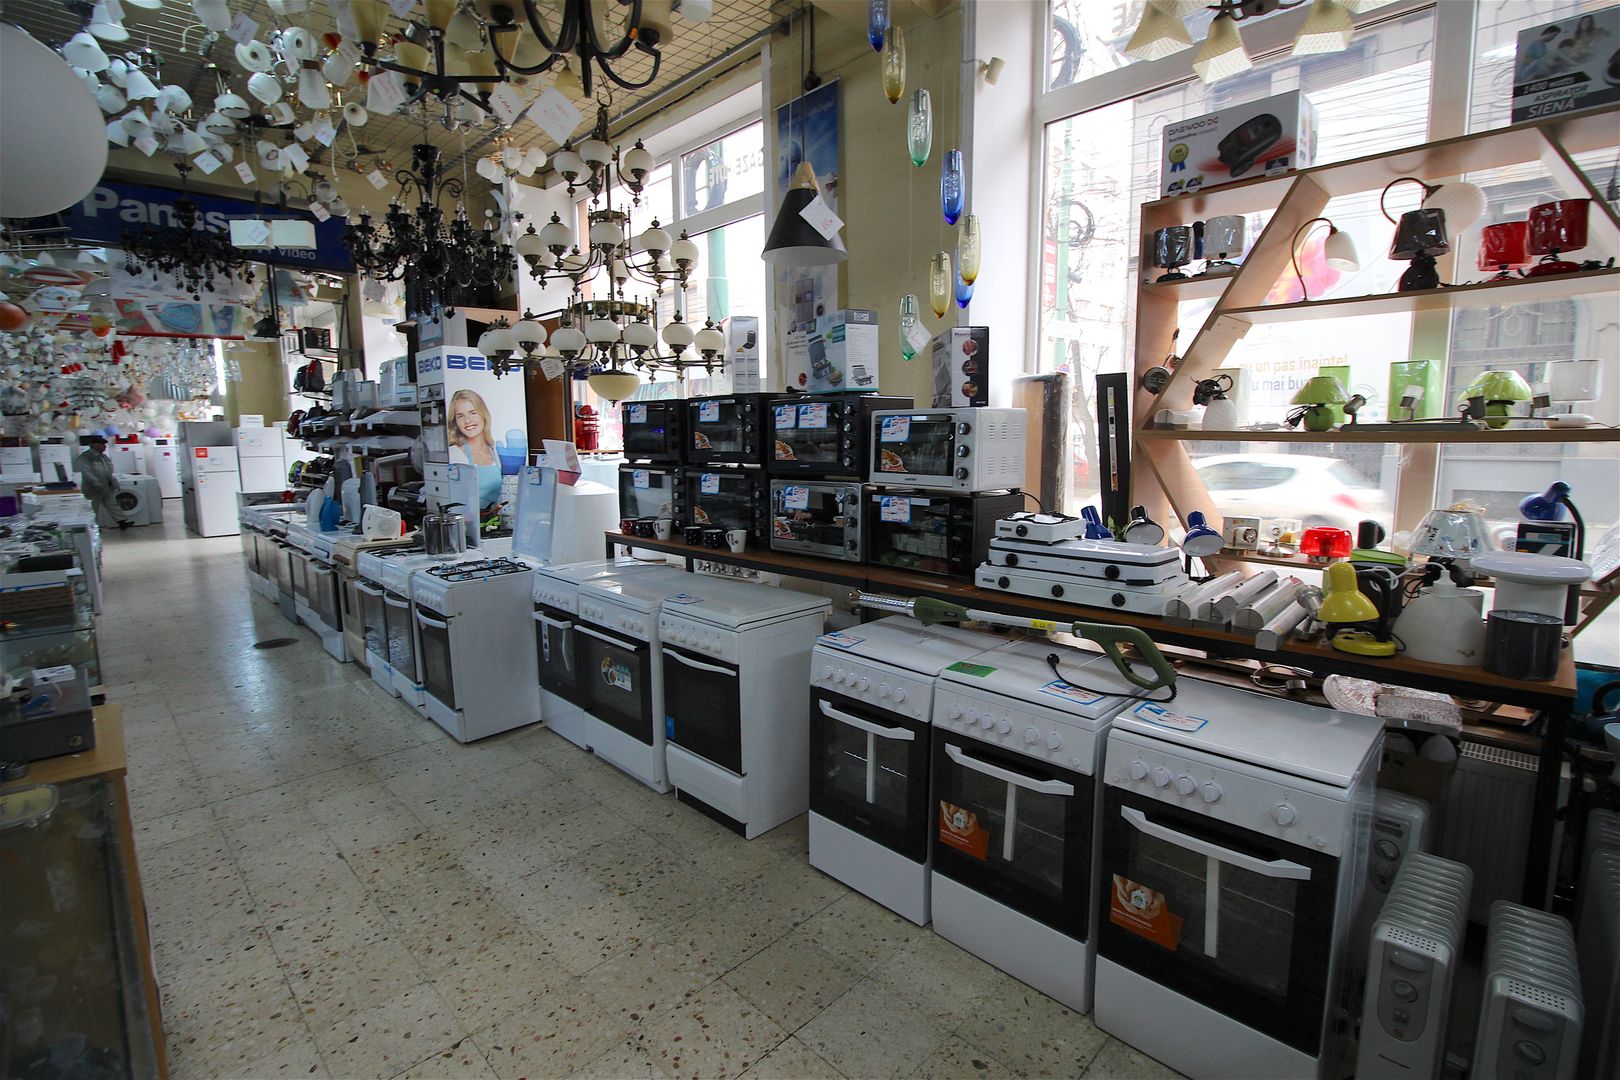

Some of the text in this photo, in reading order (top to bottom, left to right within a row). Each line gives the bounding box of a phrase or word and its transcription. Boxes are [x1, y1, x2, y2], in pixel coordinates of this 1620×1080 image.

[1534, 84, 1589, 101] ASPIRATOR
[1527, 98, 1576, 118] SIENA
[1168, 119, 1206, 136] DAEWOO
[82, 185, 231, 234] Panas
[278, 248, 317, 261] Video
[418, 355, 442, 375] BEKO
[446, 354, 521, 372] BE
[1255, 363, 1270, 373] un
[1273, 360, 1296, 375] pas
[1262, 376, 1286, 391] mai
